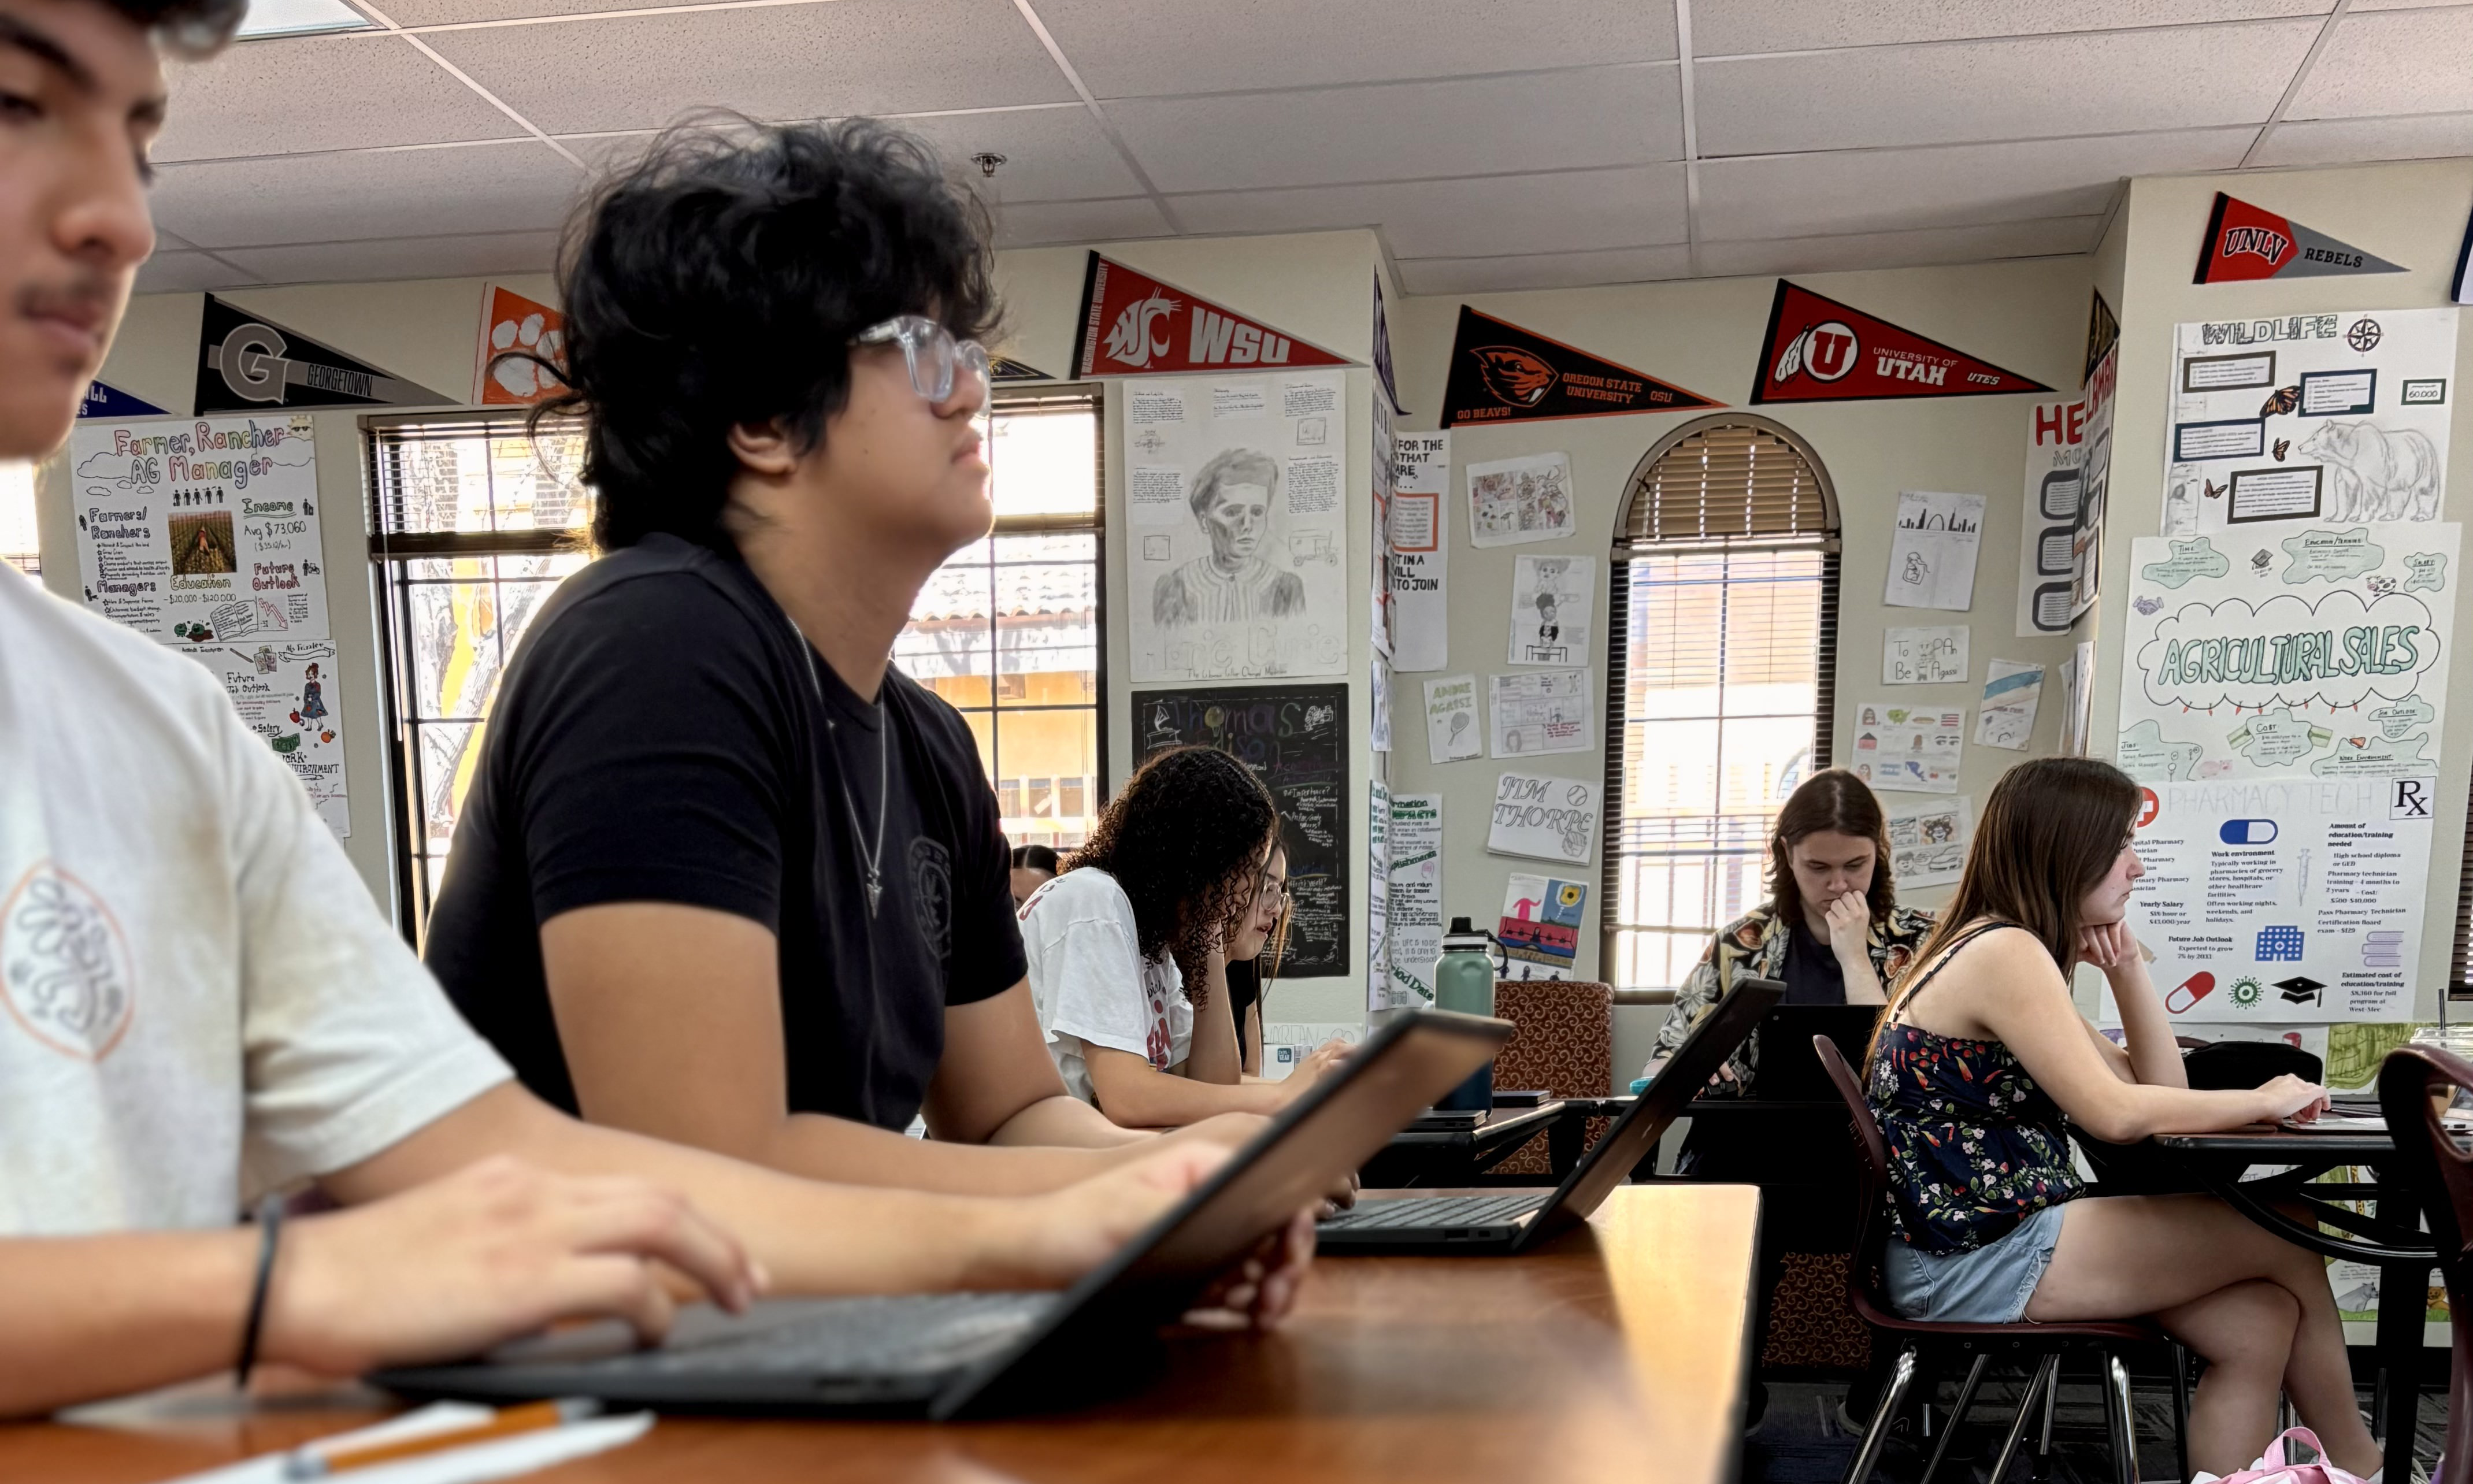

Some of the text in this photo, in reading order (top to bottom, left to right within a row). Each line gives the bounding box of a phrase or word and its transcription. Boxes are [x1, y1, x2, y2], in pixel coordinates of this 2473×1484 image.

[2222, 227, 2289, 265] UNLV
[2304, 247, 2363, 269] REBELS
[1189, 305, 1290, 363] WSU
[2202, 314, 2337, 345] WILDLIFE
[1812, 330, 1853, 376] U
[1873, 347, 1958, 368] UNIVERSITY OF
[220, 322, 291, 405] G
[1877, 356, 1948, 386] UTAH
[307, 364, 373, 397] GEORGETOWN
[1563, 373, 1643, 392] OREGON STATE
[1967, 372, 2001, 385] UTES
[1567, 385, 1633, 404] UNIVERSITY
[1651, 391, 1673, 402] OSU
[1457, 407, 1511, 420] GO BEAVS!
[114, 420, 284, 457] Farmer, Rancher
[1398, 439, 1443, 451] FOR THE
[1400, 452, 1430, 463] THAT
[131, 455, 273, 489] AG Manager
[242, 499, 294, 514] Income
[91, 524, 151, 540] Ranchers
[244, 525, 262, 540] Avg
[1403, 555, 1425, 565] IN A
[97, 580, 157, 596] Managers
[170, 574, 231, 591] Education
[1412, 578, 1438, 591] JOIN
[1893, 640, 1910, 656] To
[2158, 626, 2420, 685] AGRICULTURAL SALES
[1896, 661, 1911, 680] Be
[1433, 682, 1471, 700] ANDRE
[1430, 697, 1472, 715] AGASSI
[1498, 776, 1553, 803] JIM
[2168, 781, 2371, 815] PHARMACY TECH
[1495, 803, 1593, 834] THORPE
